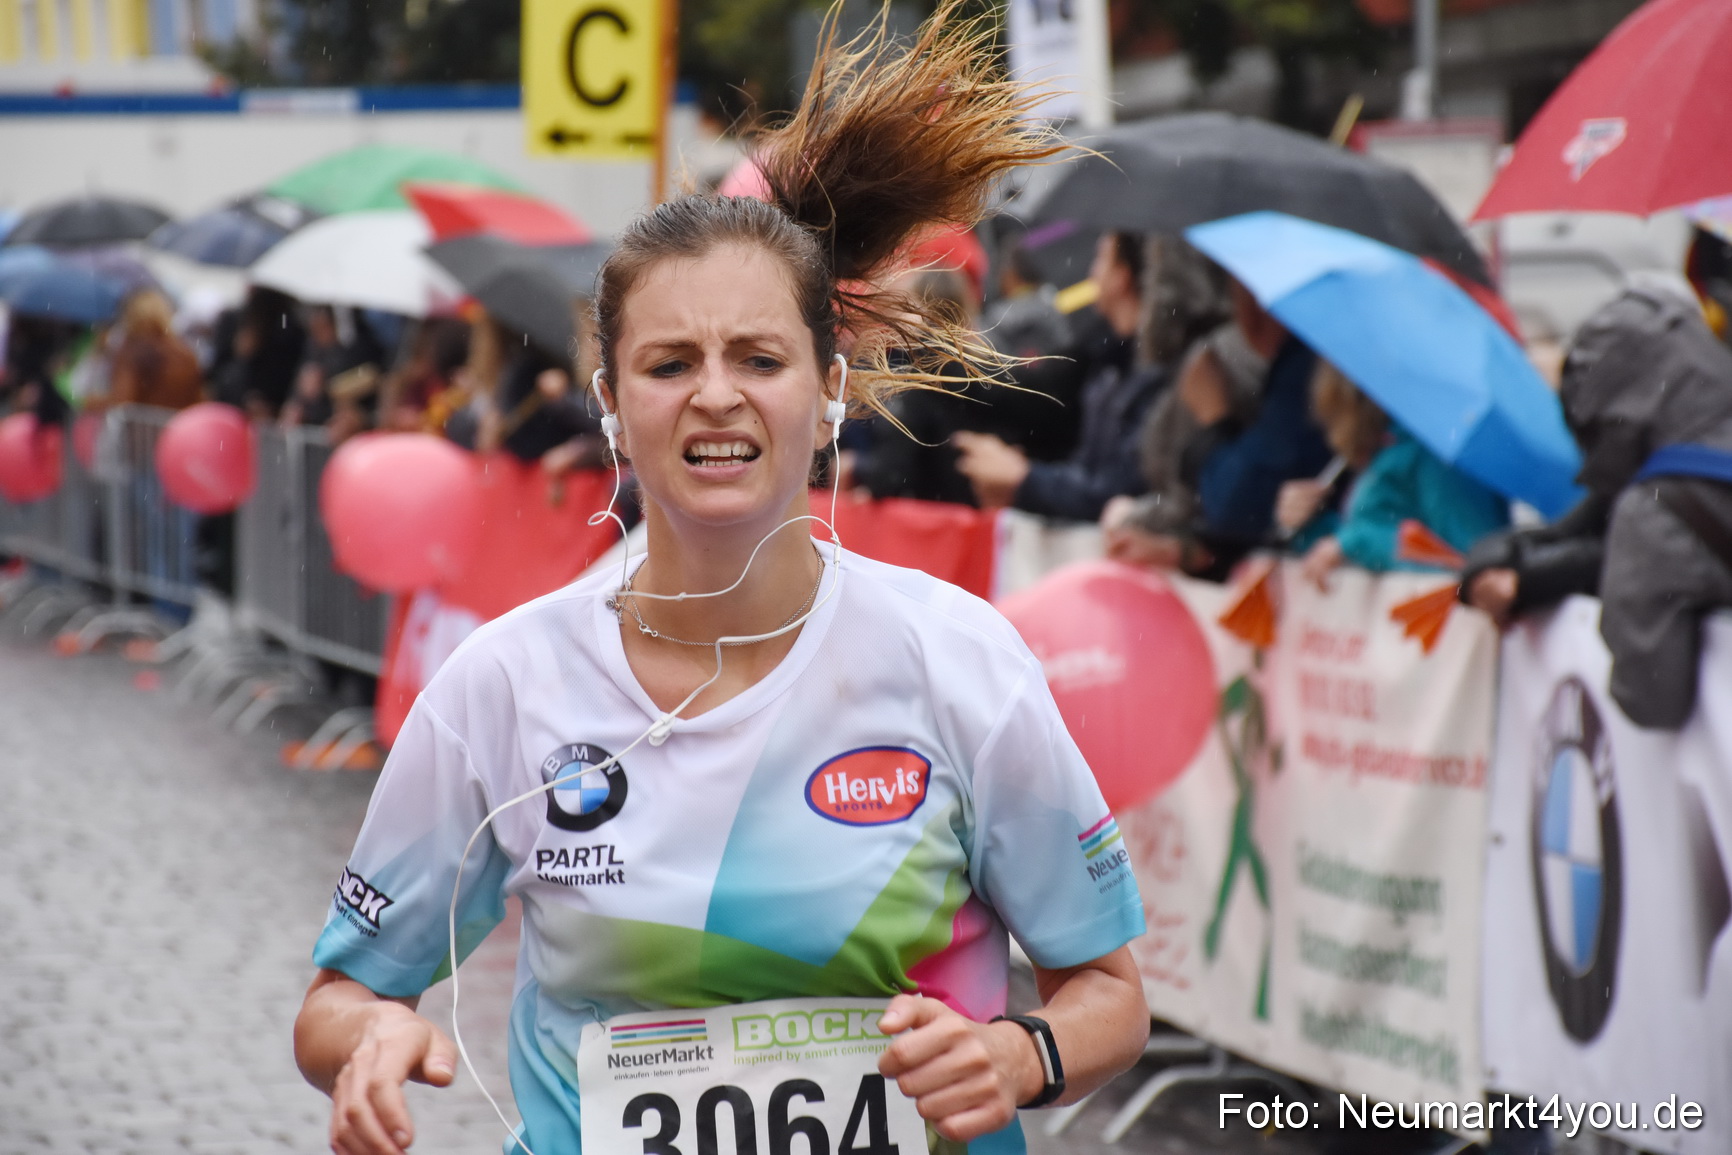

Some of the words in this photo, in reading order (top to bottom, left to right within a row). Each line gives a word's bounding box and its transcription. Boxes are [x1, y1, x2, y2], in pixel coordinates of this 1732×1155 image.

[566, 8, 629, 107] C
[544, 745, 619, 776] BMW
[824, 767, 920, 805] Hervis
[835, 802, 883, 813] SPORTS
[536, 844, 624, 871] PARTL
[1086, 849, 1129, 882] Neue
[732, 1008, 890, 1050] BOCK
[607, 1045, 714, 1069] NeuerMarkt
[734, 1051, 783, 1066] inspired
[786, 1050, 801, 1063] by
[804, 1048, 838, 1060] smart
[841, 1043, 890, 1056] concept
[614, 1070, 650, 1080] einkaufen
[653, 1067, 673, 1077] leben
[622, 1073, 899, 1155] 3064
